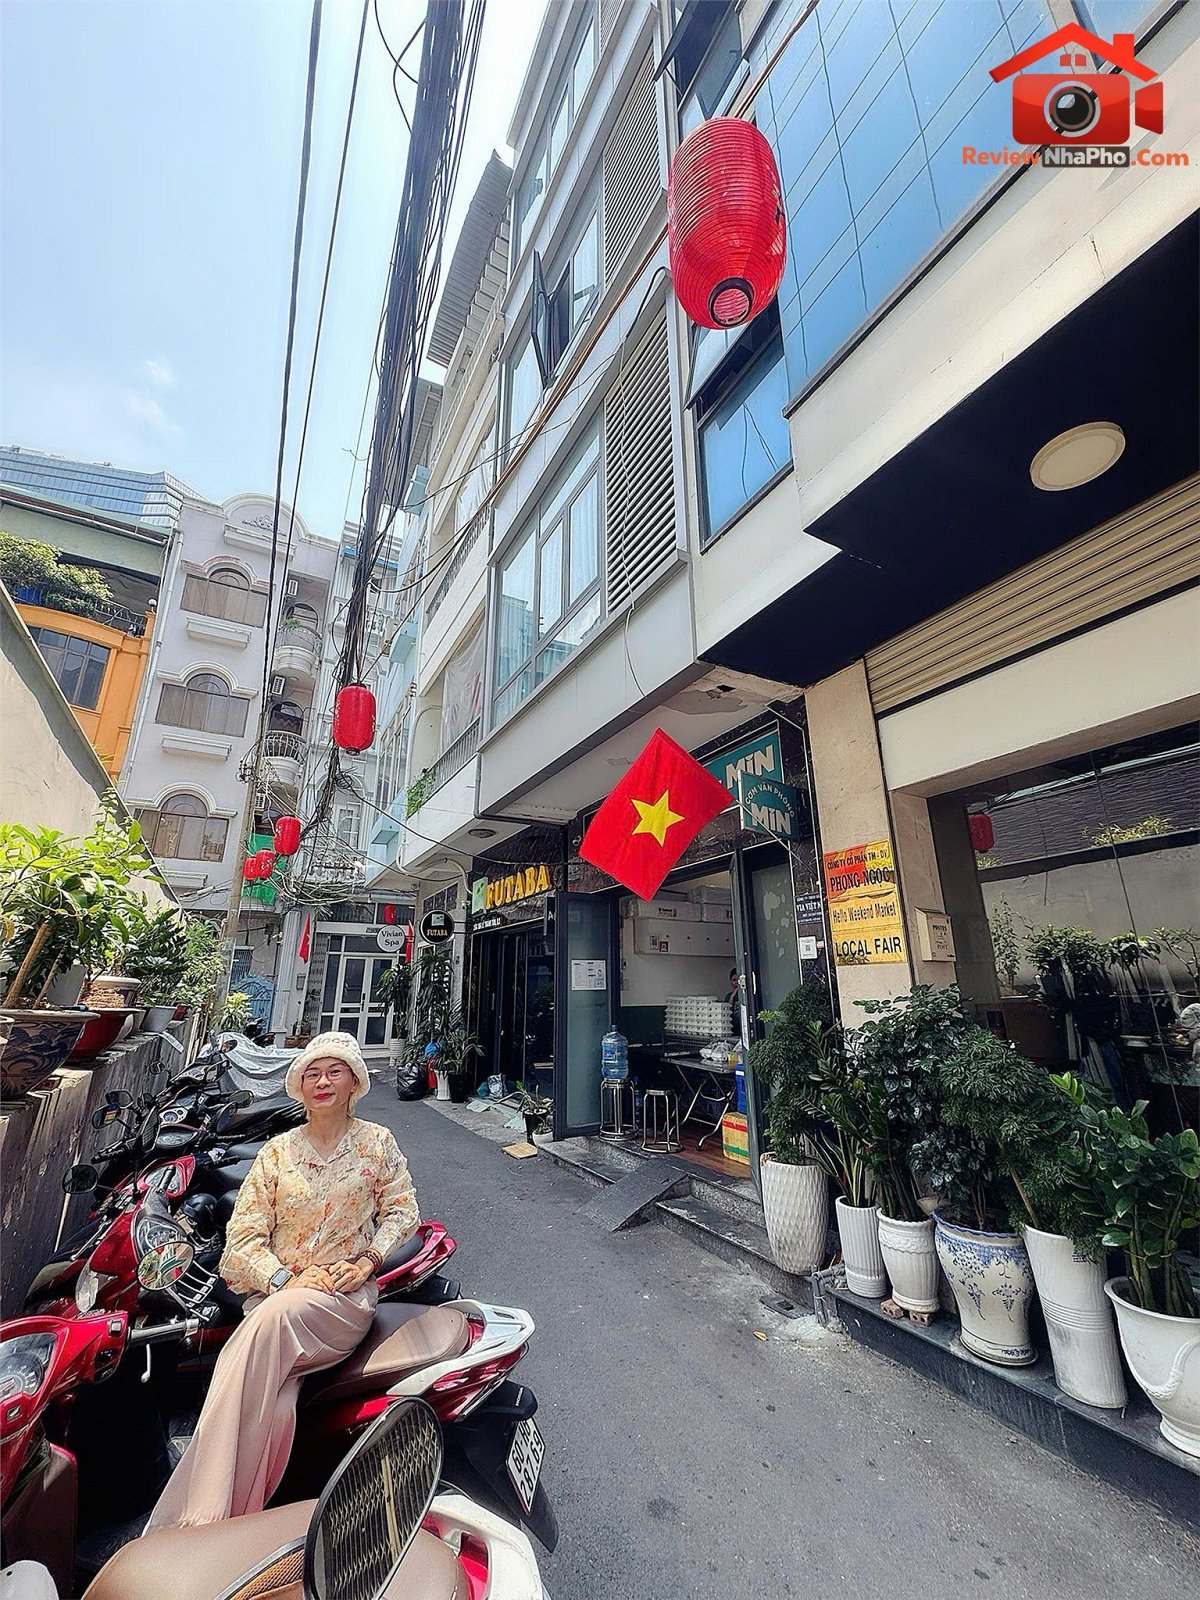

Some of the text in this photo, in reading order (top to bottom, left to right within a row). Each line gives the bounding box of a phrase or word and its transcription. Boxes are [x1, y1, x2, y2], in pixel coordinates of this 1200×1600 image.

[485, 864, 552, 911] FUTABA
[830, 867, 890, 892] PHONG NGỌC
[832, 908, 848, 924] Hello
[848, 904, 874, 922] Weekend
[874, 902, 897, 918] Market
[381, 930, 403, 938] Vivian
[384, 938, 400, 947] Spa
[426, 928, 448, 938] FUTABA
[835, 938, 872, 958] LOCAL
[874, 935, 903, 955] FAIR
